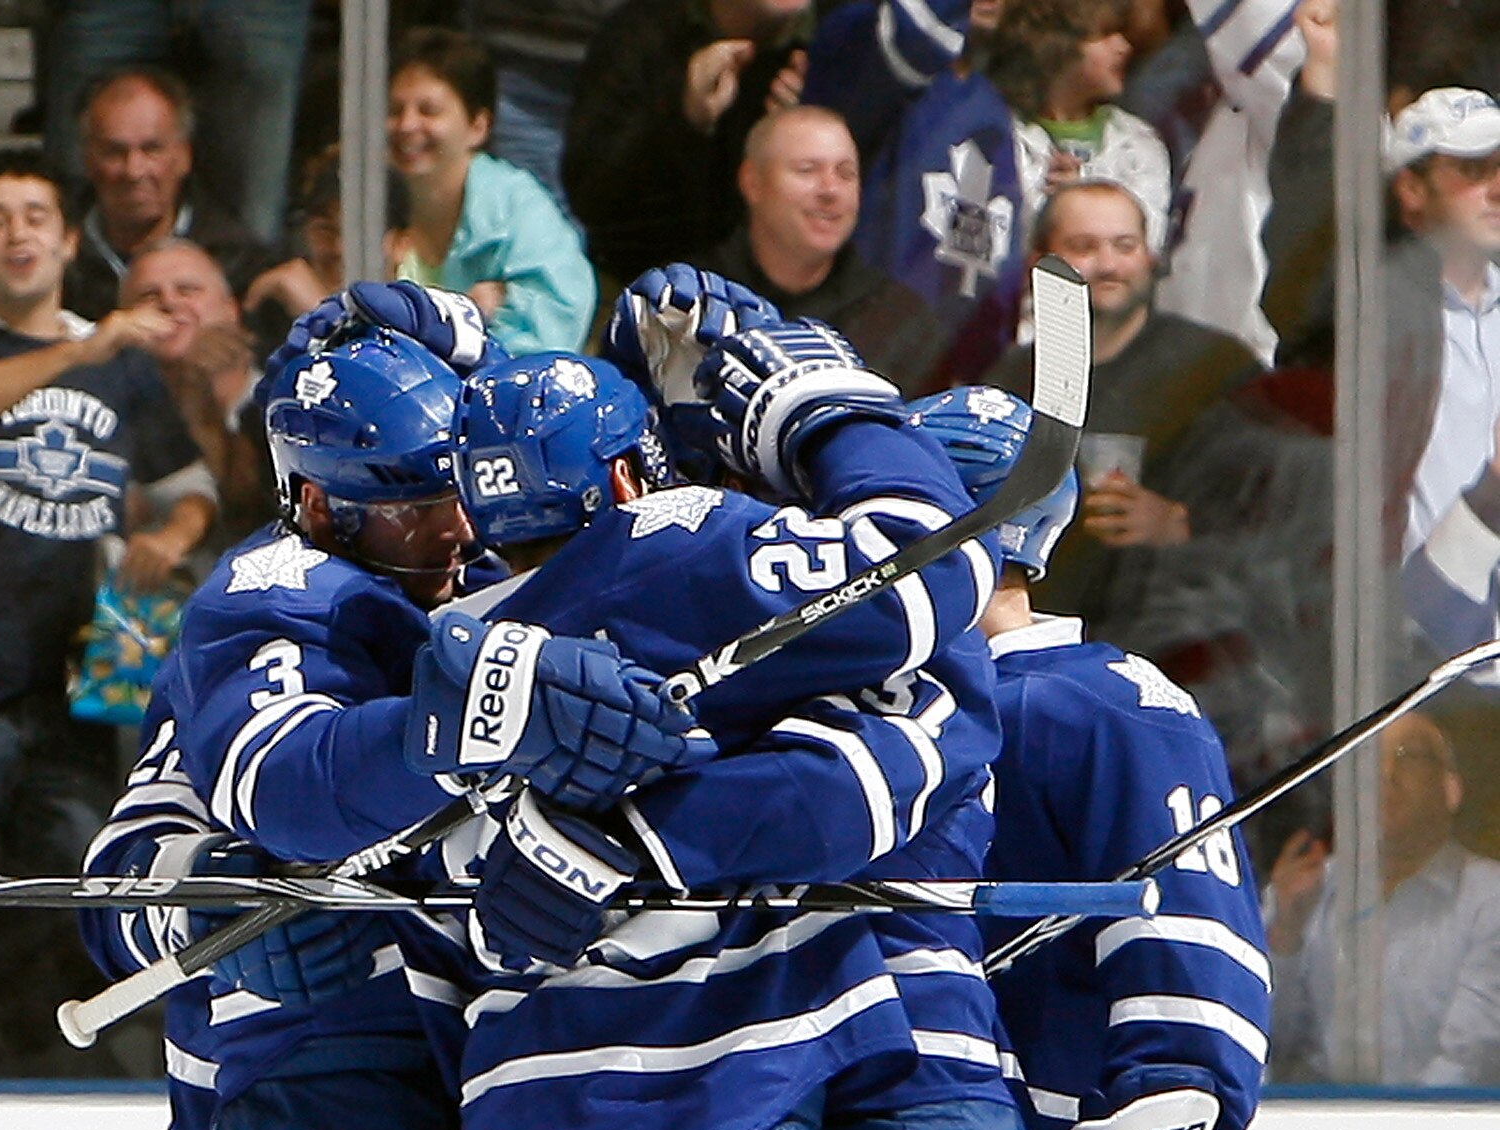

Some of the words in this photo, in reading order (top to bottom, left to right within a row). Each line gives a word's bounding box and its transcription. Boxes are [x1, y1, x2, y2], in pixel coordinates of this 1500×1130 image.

[473, 455, 520, 498] 22
[749, 505, 848, 593] 22
[248, 638, 305, 711] 3
[470, 627, 531, 747] Reebo
[508, 803, 607, 897] TON
